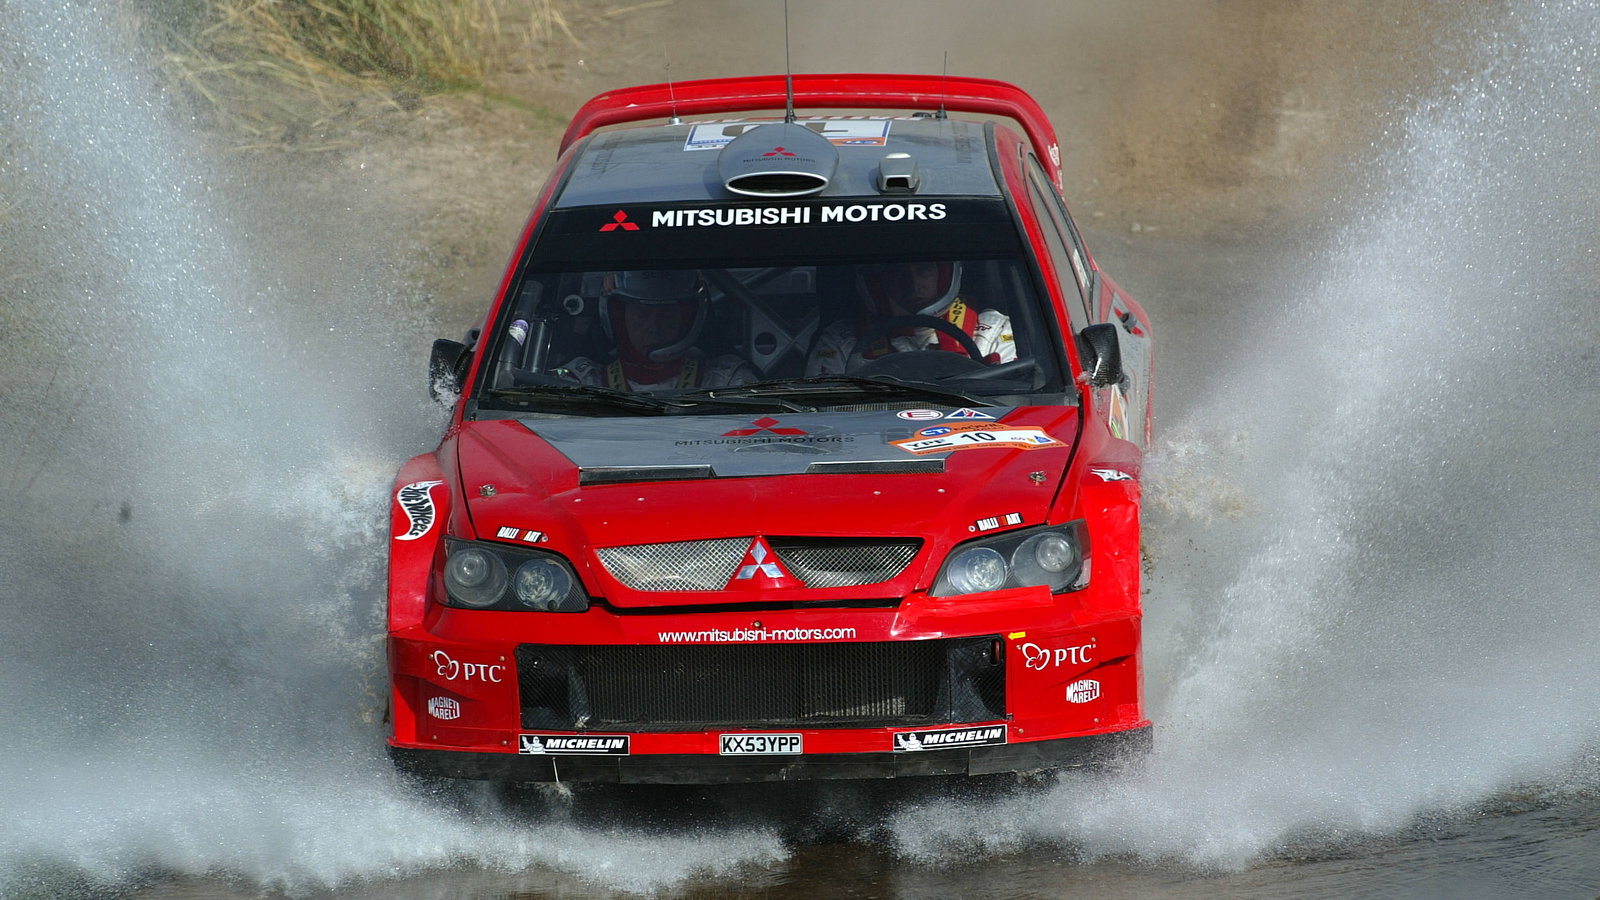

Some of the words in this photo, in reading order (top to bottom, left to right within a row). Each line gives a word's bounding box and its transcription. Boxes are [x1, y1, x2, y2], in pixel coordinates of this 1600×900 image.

[652, 207, 810, 228] MITSUBISHI
[821, 203, 947, 222] MOTORS
[674, 437, 773, 447] MITSUBISHI
[778, 435, 855, 444] MOTORS
[960, 431, 996, 443] 10
[1054, 644, 1093, 667] PTC
[463, 663, 503, 683] PTC
[545, 738, 625, 749] MICHELIN
[923, 728, 1003, 745] MICHELIN
[722, 737, 800, 753] KX53YPP
